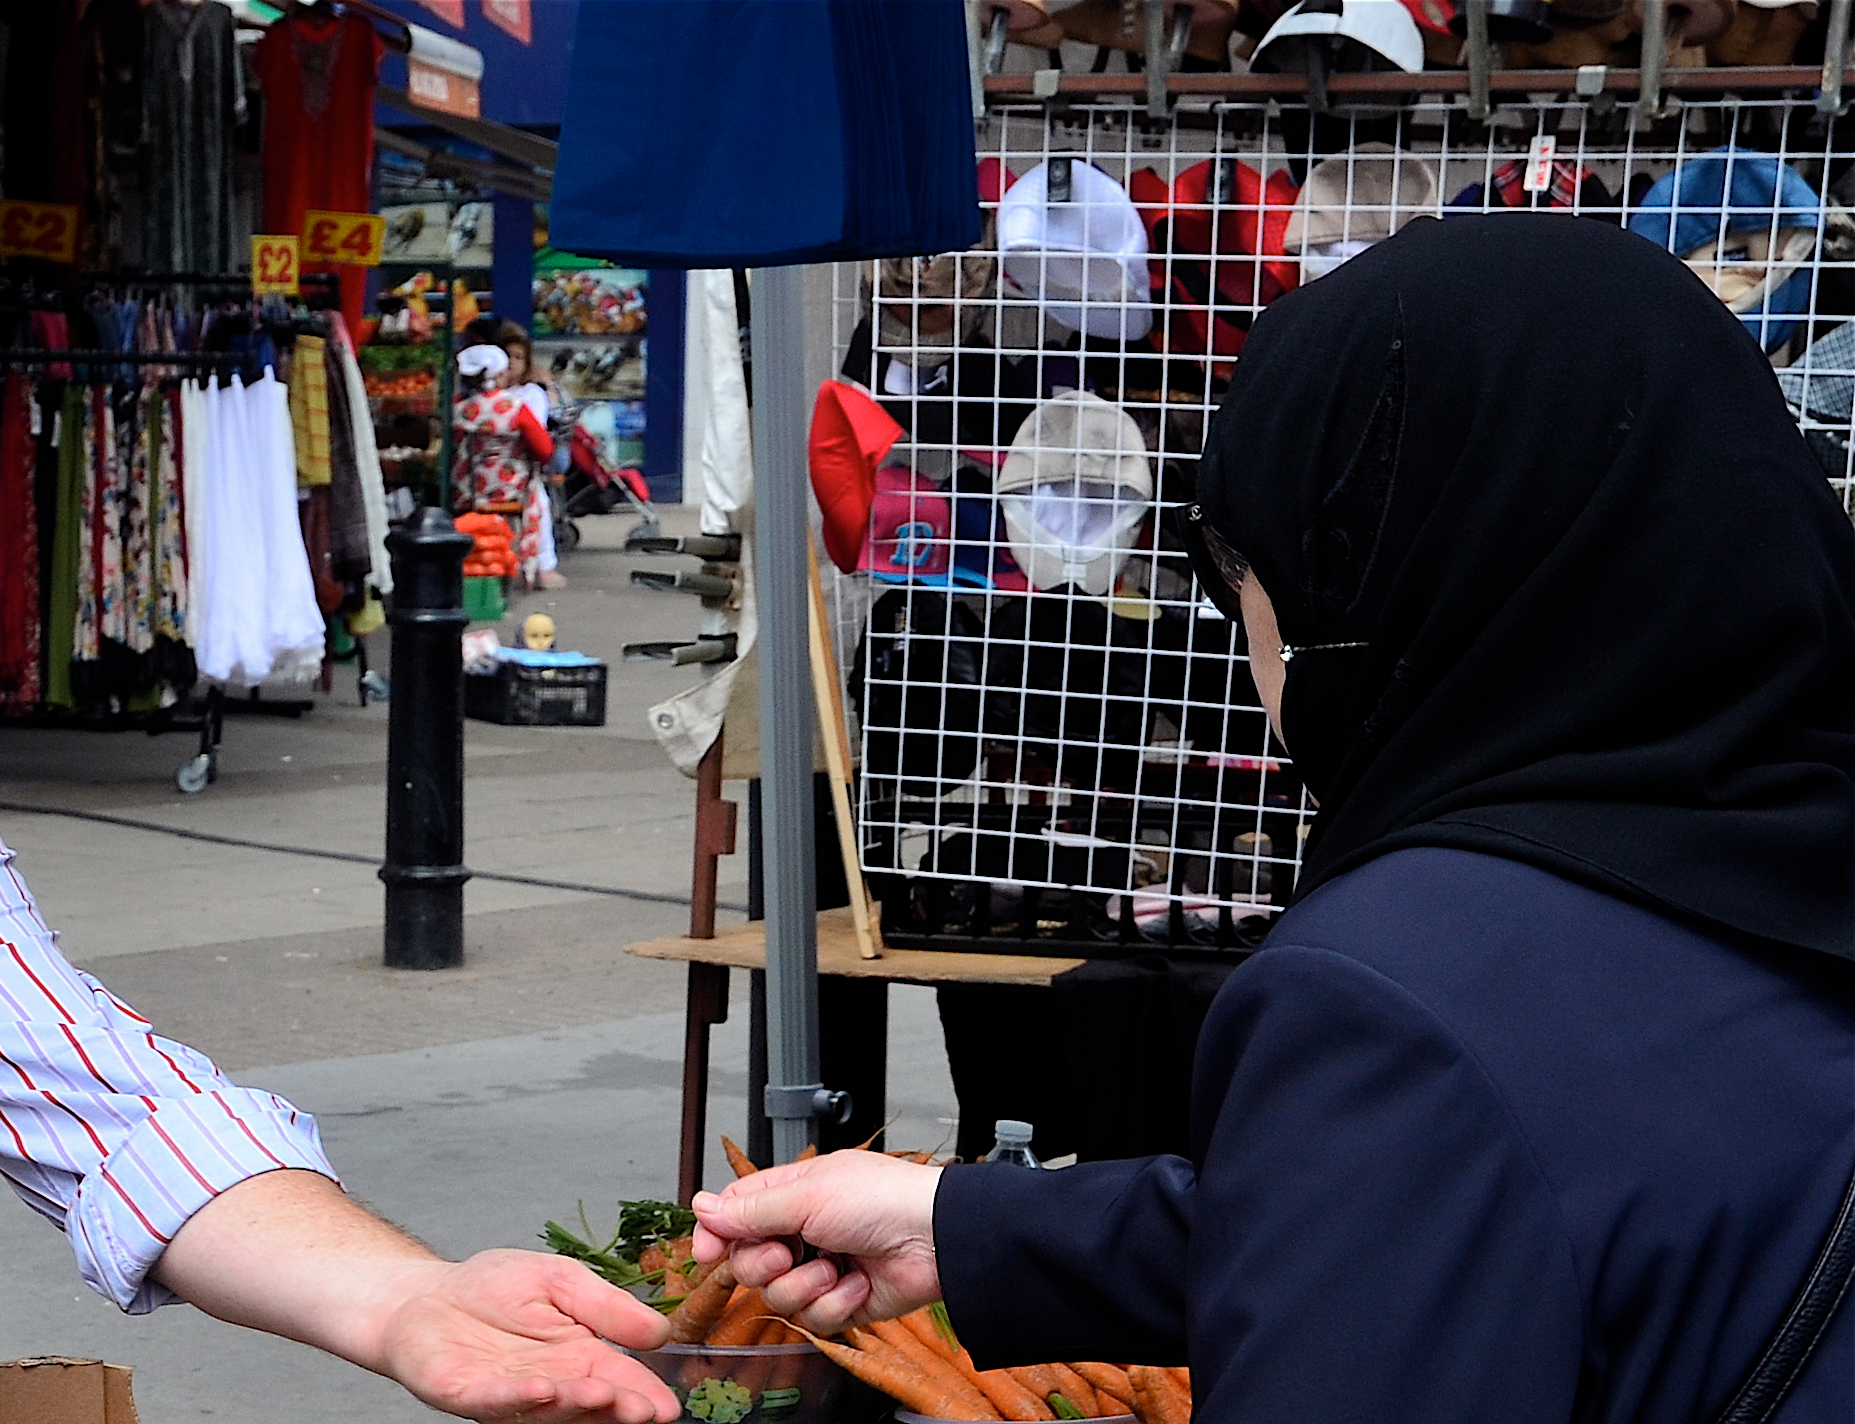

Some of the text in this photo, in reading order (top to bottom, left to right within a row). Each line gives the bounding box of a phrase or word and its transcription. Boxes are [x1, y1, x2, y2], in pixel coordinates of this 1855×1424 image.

[1, 208, 67, 254] £2
[308, 218, 373, 258] £4
[258, 244, 292, 284] £2
